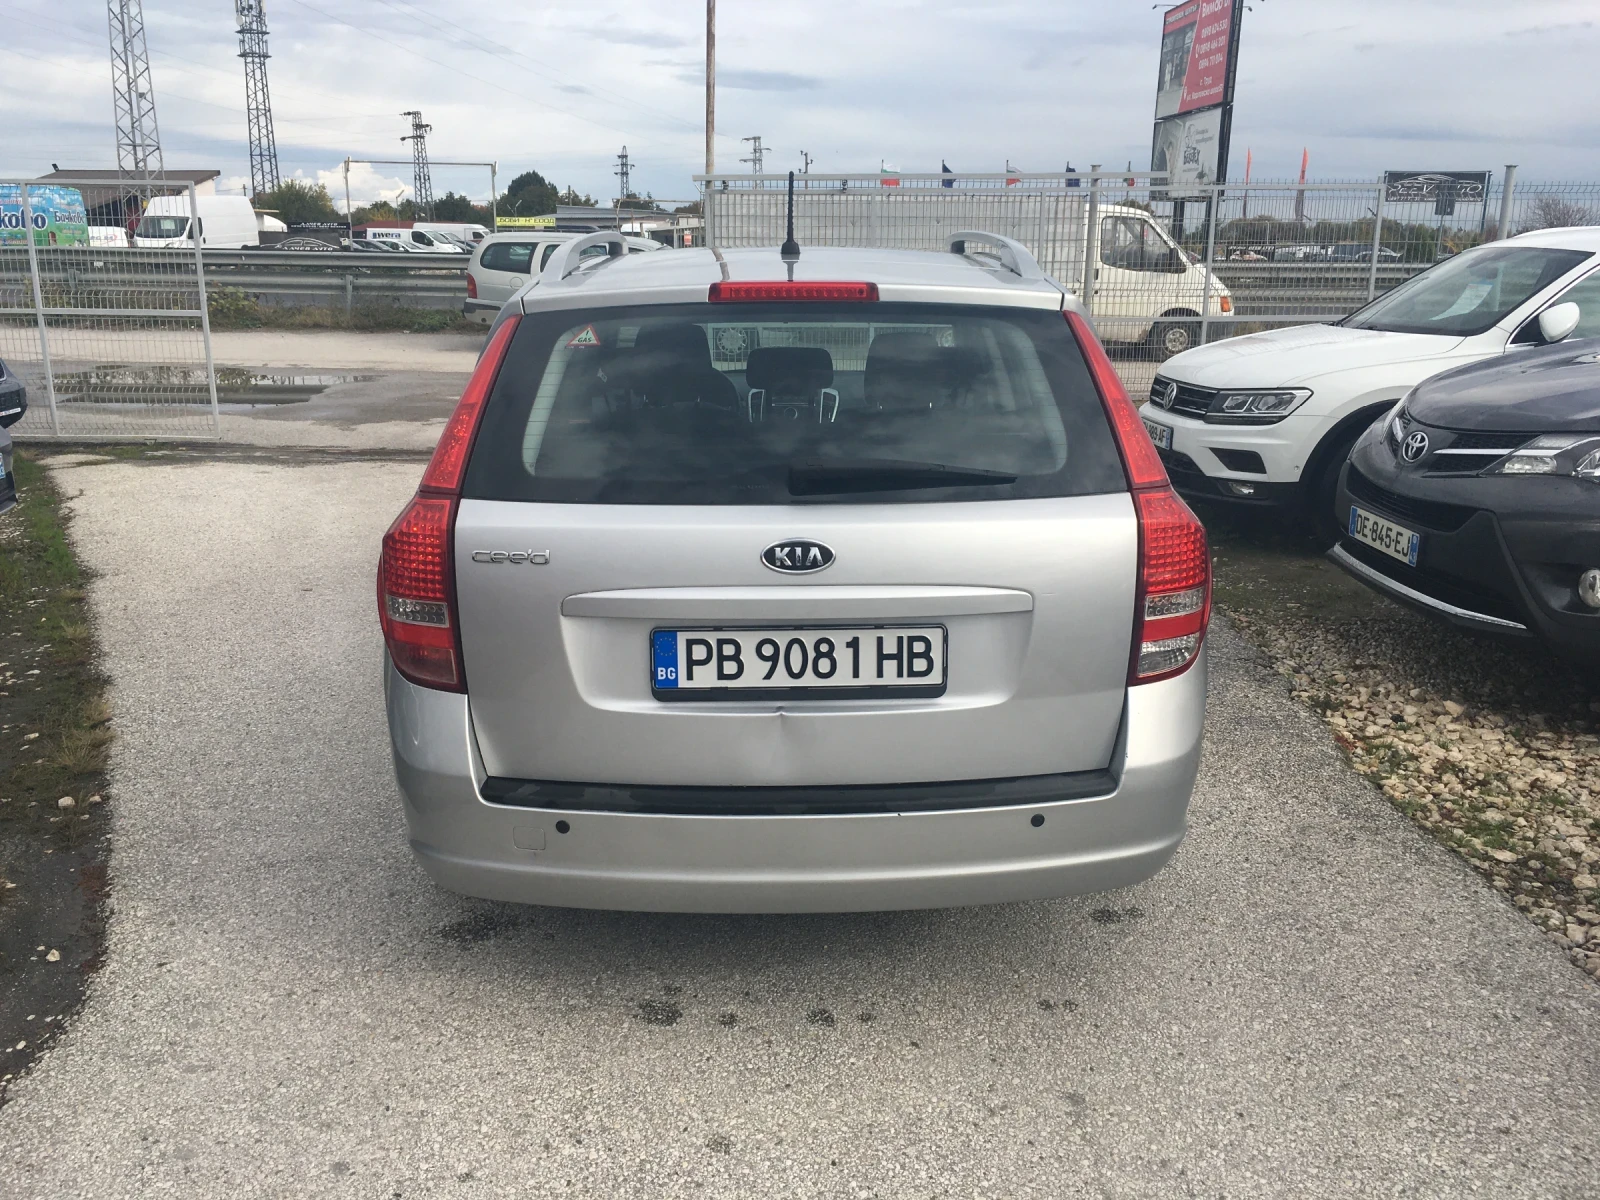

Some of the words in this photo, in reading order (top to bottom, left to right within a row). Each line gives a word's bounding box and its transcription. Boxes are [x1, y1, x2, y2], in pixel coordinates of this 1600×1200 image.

[471, 549, 550, 565] cee'd
[773, 546, 824, 567] KIA
[685, 638, 745, 681] PB
[755, 636, 860, 680] 9081
[876, 634, 934, 679] HB
[657, 667, 677, 680] BG
